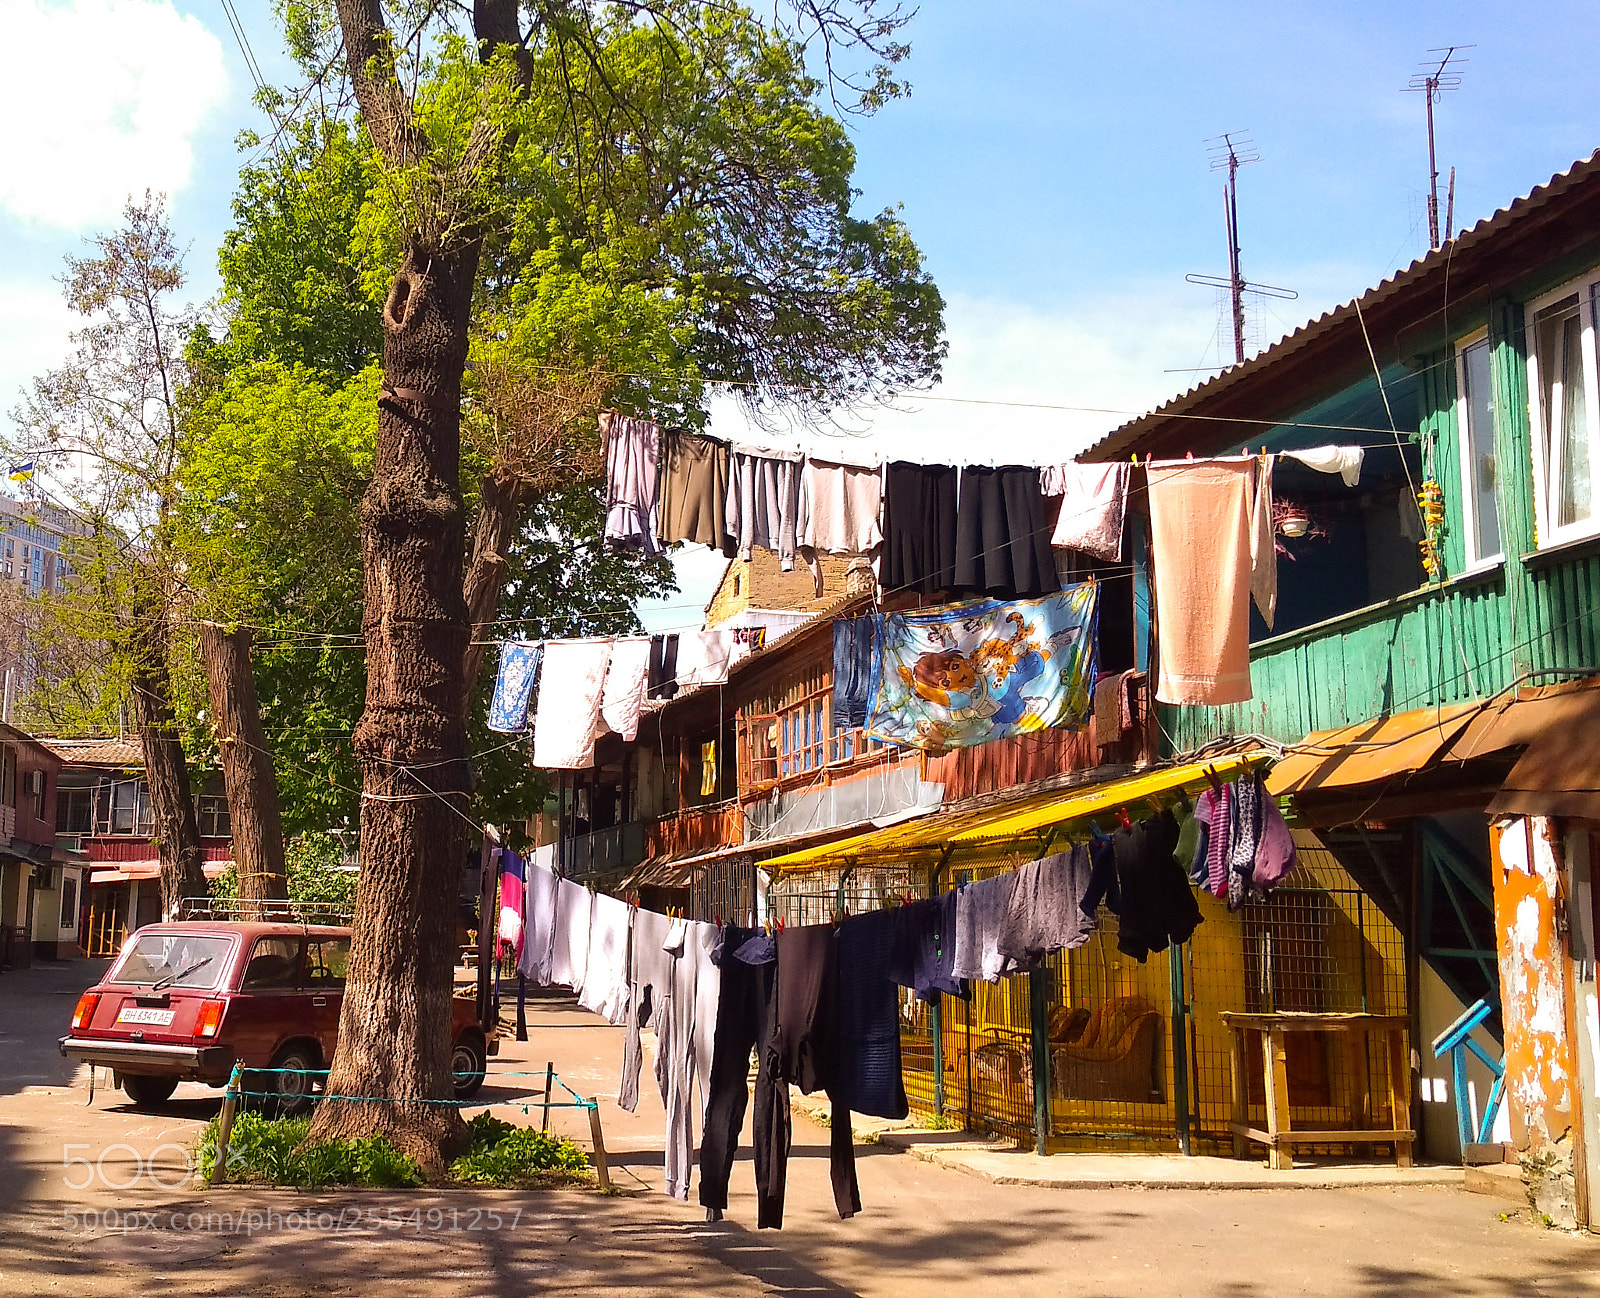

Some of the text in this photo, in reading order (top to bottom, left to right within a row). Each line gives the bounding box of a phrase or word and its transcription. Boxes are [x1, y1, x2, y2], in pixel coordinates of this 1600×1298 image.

[123, 1010, 172, 1023] BH 6341 AE
